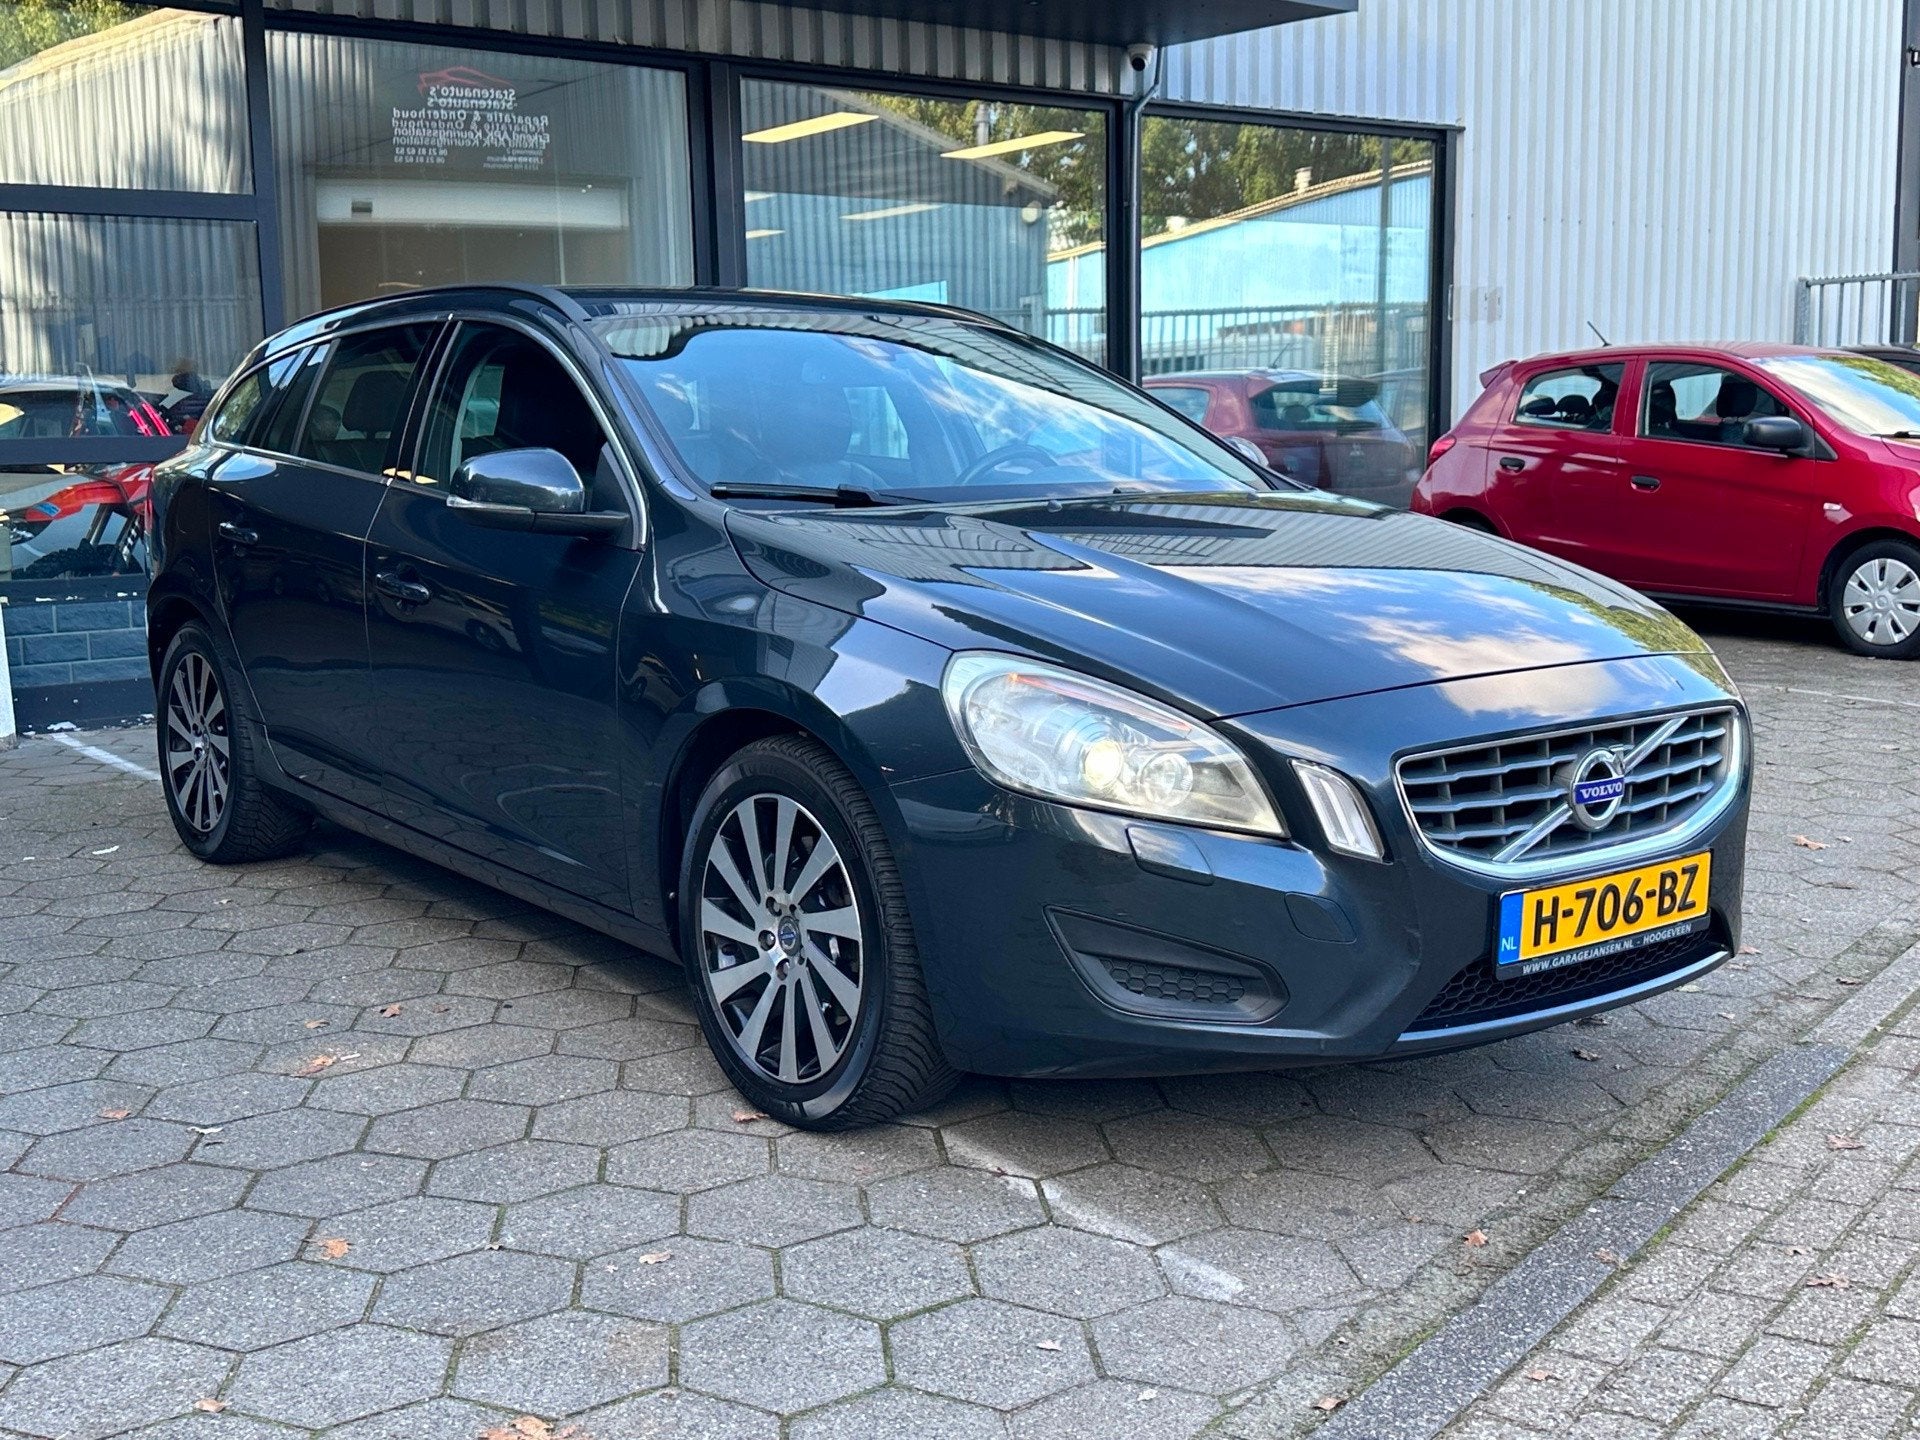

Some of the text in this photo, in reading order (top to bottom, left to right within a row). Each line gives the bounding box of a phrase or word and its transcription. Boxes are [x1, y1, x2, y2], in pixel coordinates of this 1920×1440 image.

[1580, 782, 1622, 799] VOLVO
[1533, 863, 1699, 947] H-706-BZ
[1501, 937, 1517, 952] NL
[1522, 940, 1634, 974] WWW.GARAGEJANSEN.NL
[1643, 923, 1692, 944] HOOGEVEEN
